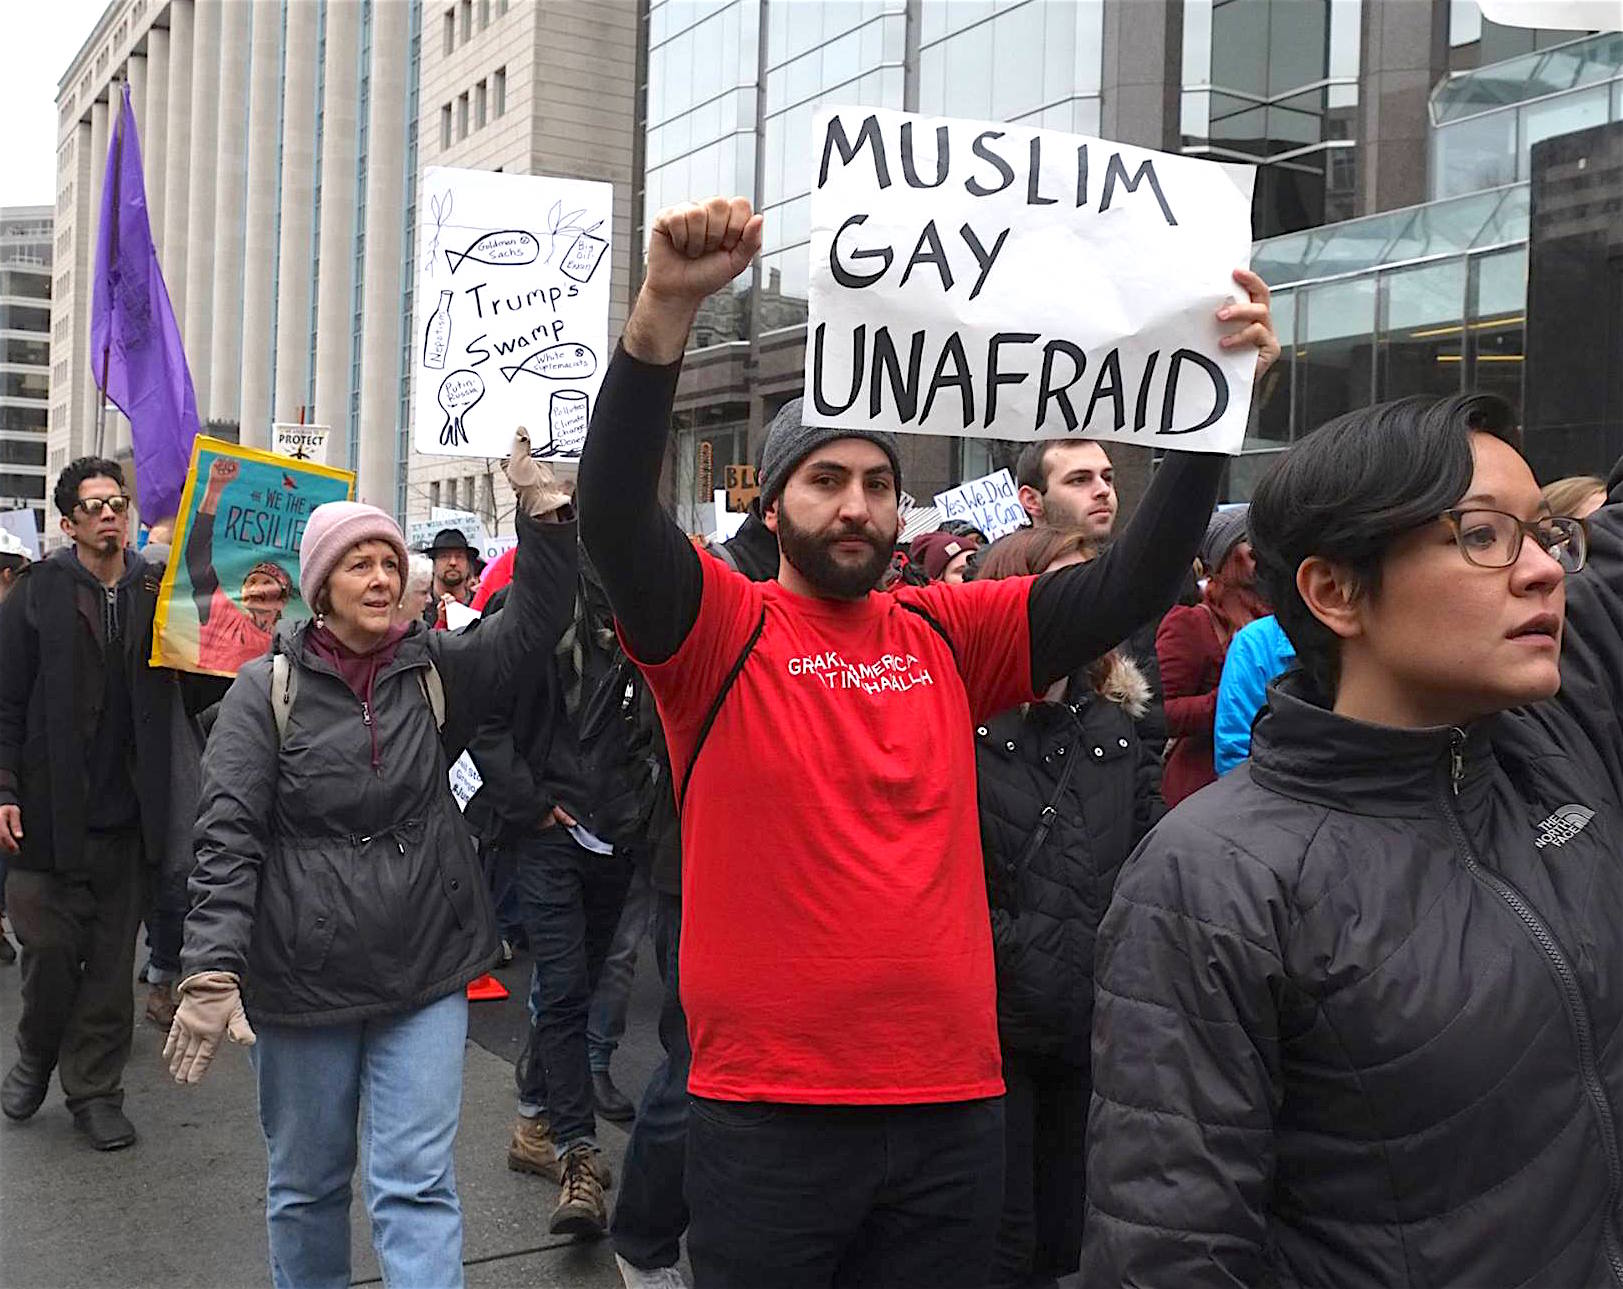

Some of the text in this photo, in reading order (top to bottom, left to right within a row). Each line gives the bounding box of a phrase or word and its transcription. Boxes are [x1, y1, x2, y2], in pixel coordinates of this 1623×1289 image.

[817, 114, 1178, 226] MUSLIM
[477, 239, 517, 251] Goldman
[829, 213, 1010, 300] GAY
[465, 283, 579, 318] Trump's
[465, 320, 564, 367] Swamp
[813, 322, 1230, 435] UNAFRAID
[279, 434, 324, 446] PROTECT
[265, 488, 307, 515] WE THE
[938, 495, 966, 518] Yes
[960, 484, 986, 510] We
[982, 472, 1014, 504] Did
[225, 505, 307, 553] RESILIE
[972, 507, 997, 533] We
[994, 503, 1026, 525] Can
[1534, 819, 1572, 848] NORTH
[1537, 814, 1561, 831] THE
[1551, 825, 1581, 847] FACE
